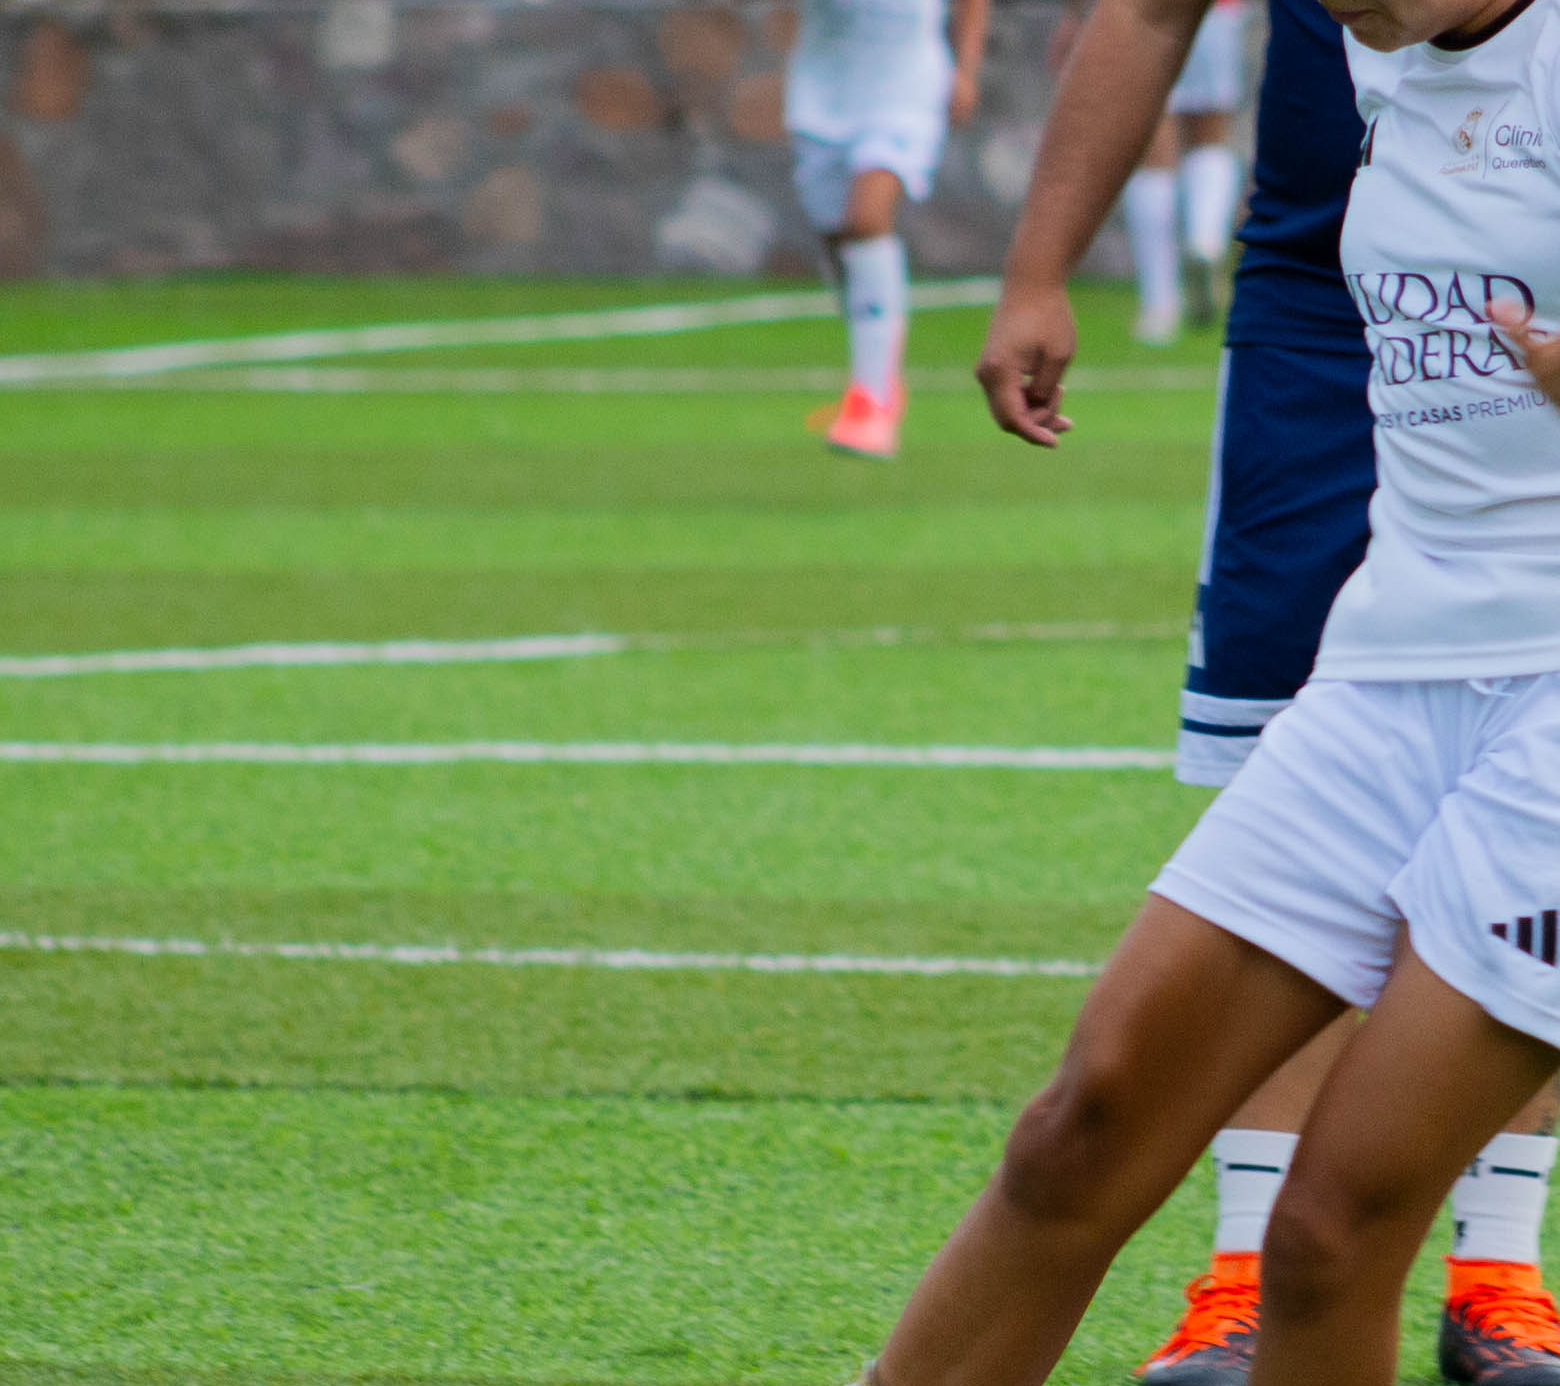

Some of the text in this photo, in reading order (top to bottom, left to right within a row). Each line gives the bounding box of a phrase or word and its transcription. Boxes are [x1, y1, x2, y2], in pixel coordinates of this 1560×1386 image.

[1376, 326, 1549, 386] DERA
[1407, 405, 1463, 426] CASAS
[1466, 391, 1548, 420] PREMIU
